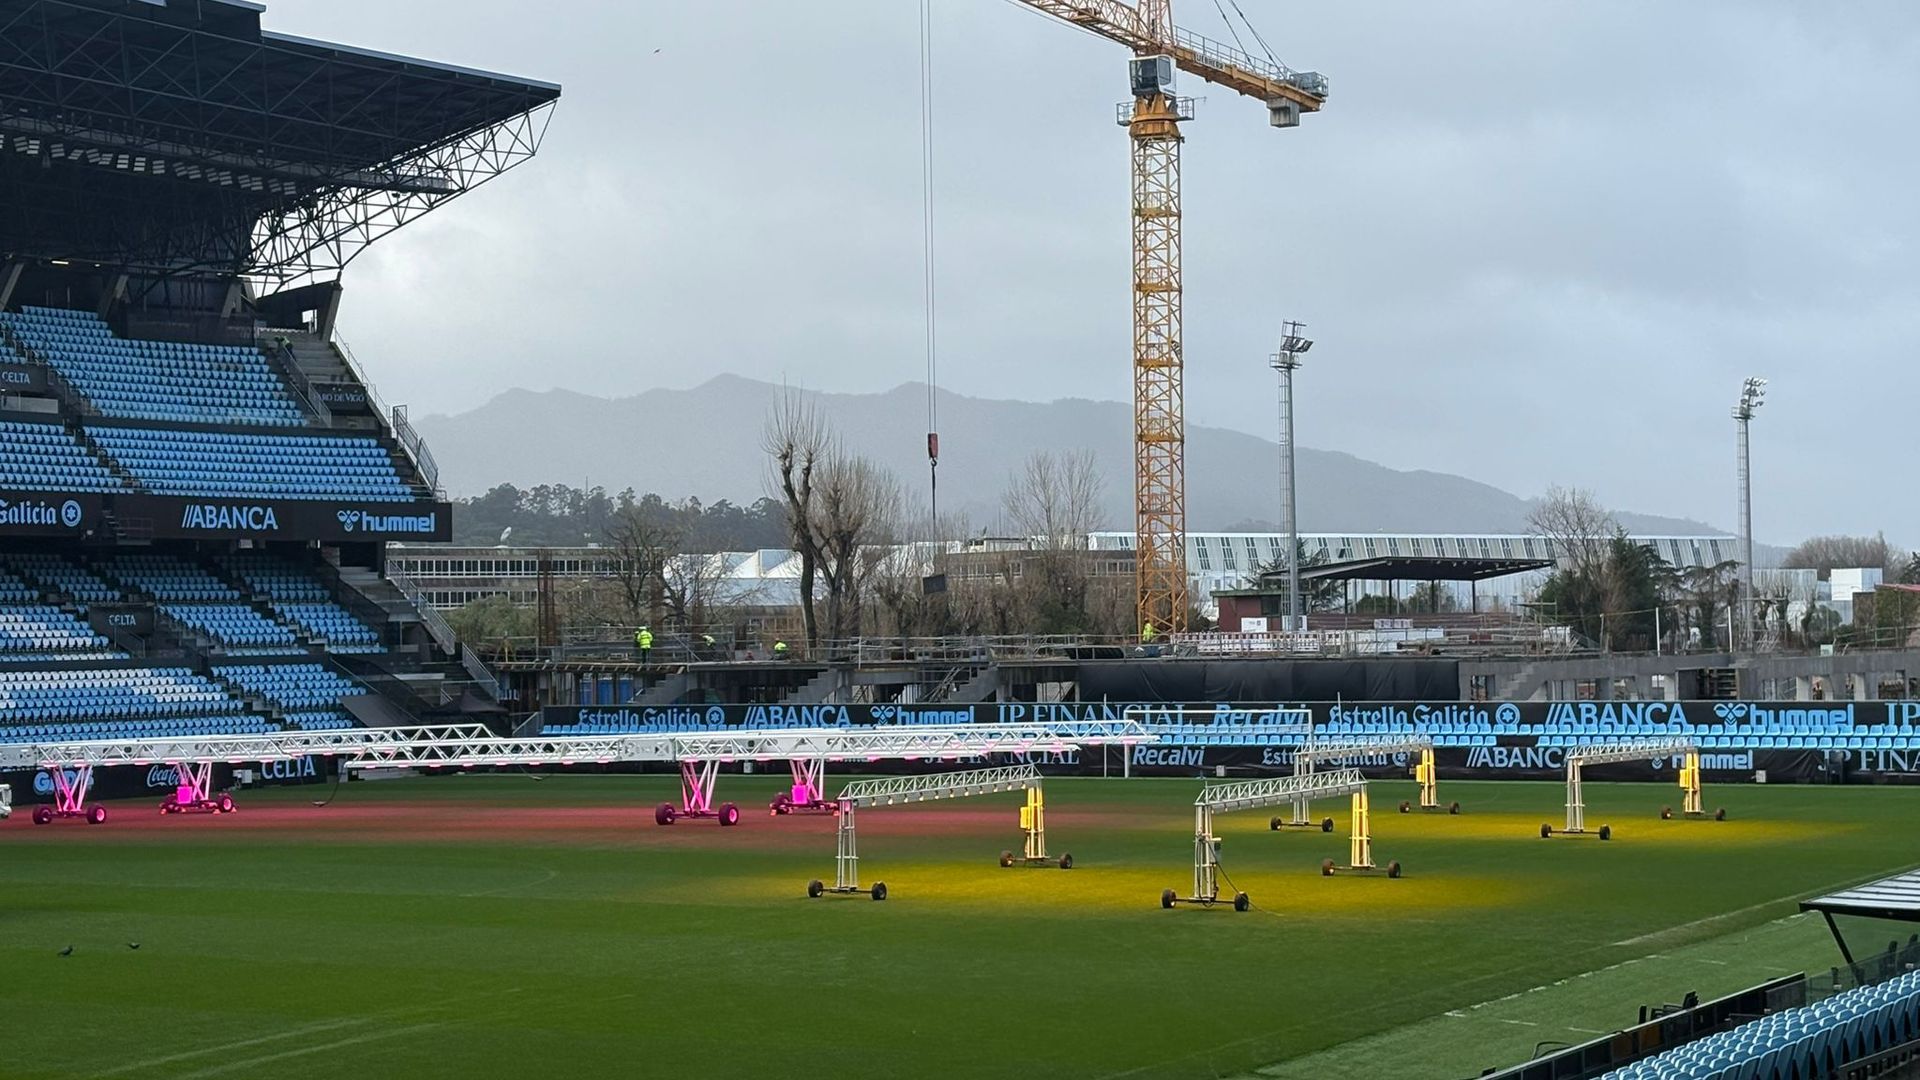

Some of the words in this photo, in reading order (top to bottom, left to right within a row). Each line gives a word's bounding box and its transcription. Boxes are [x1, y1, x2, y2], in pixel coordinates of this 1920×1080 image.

[1, 371, 31, 385] CELTA
[361, 512, 436, 533] hummel
[109, 614, 137, 626] CELTA
[578, 708, 639, 726] Estrella
[643, 707, 701, 726] Galicia
[897, 705, 975, 725] hummel
[1213, 704, 1306, 726] Recalvi
[1329, 705, 1408, 727] Estrella
[1412, 704, 1489, 727] Galicia
[1749, 704, 1855, 728] hummel
[1132, 745, 1206, 766] Recalvi
[1671, 749, 1753, 770] hmmel
[261, 755, 317, 779] CELTA
